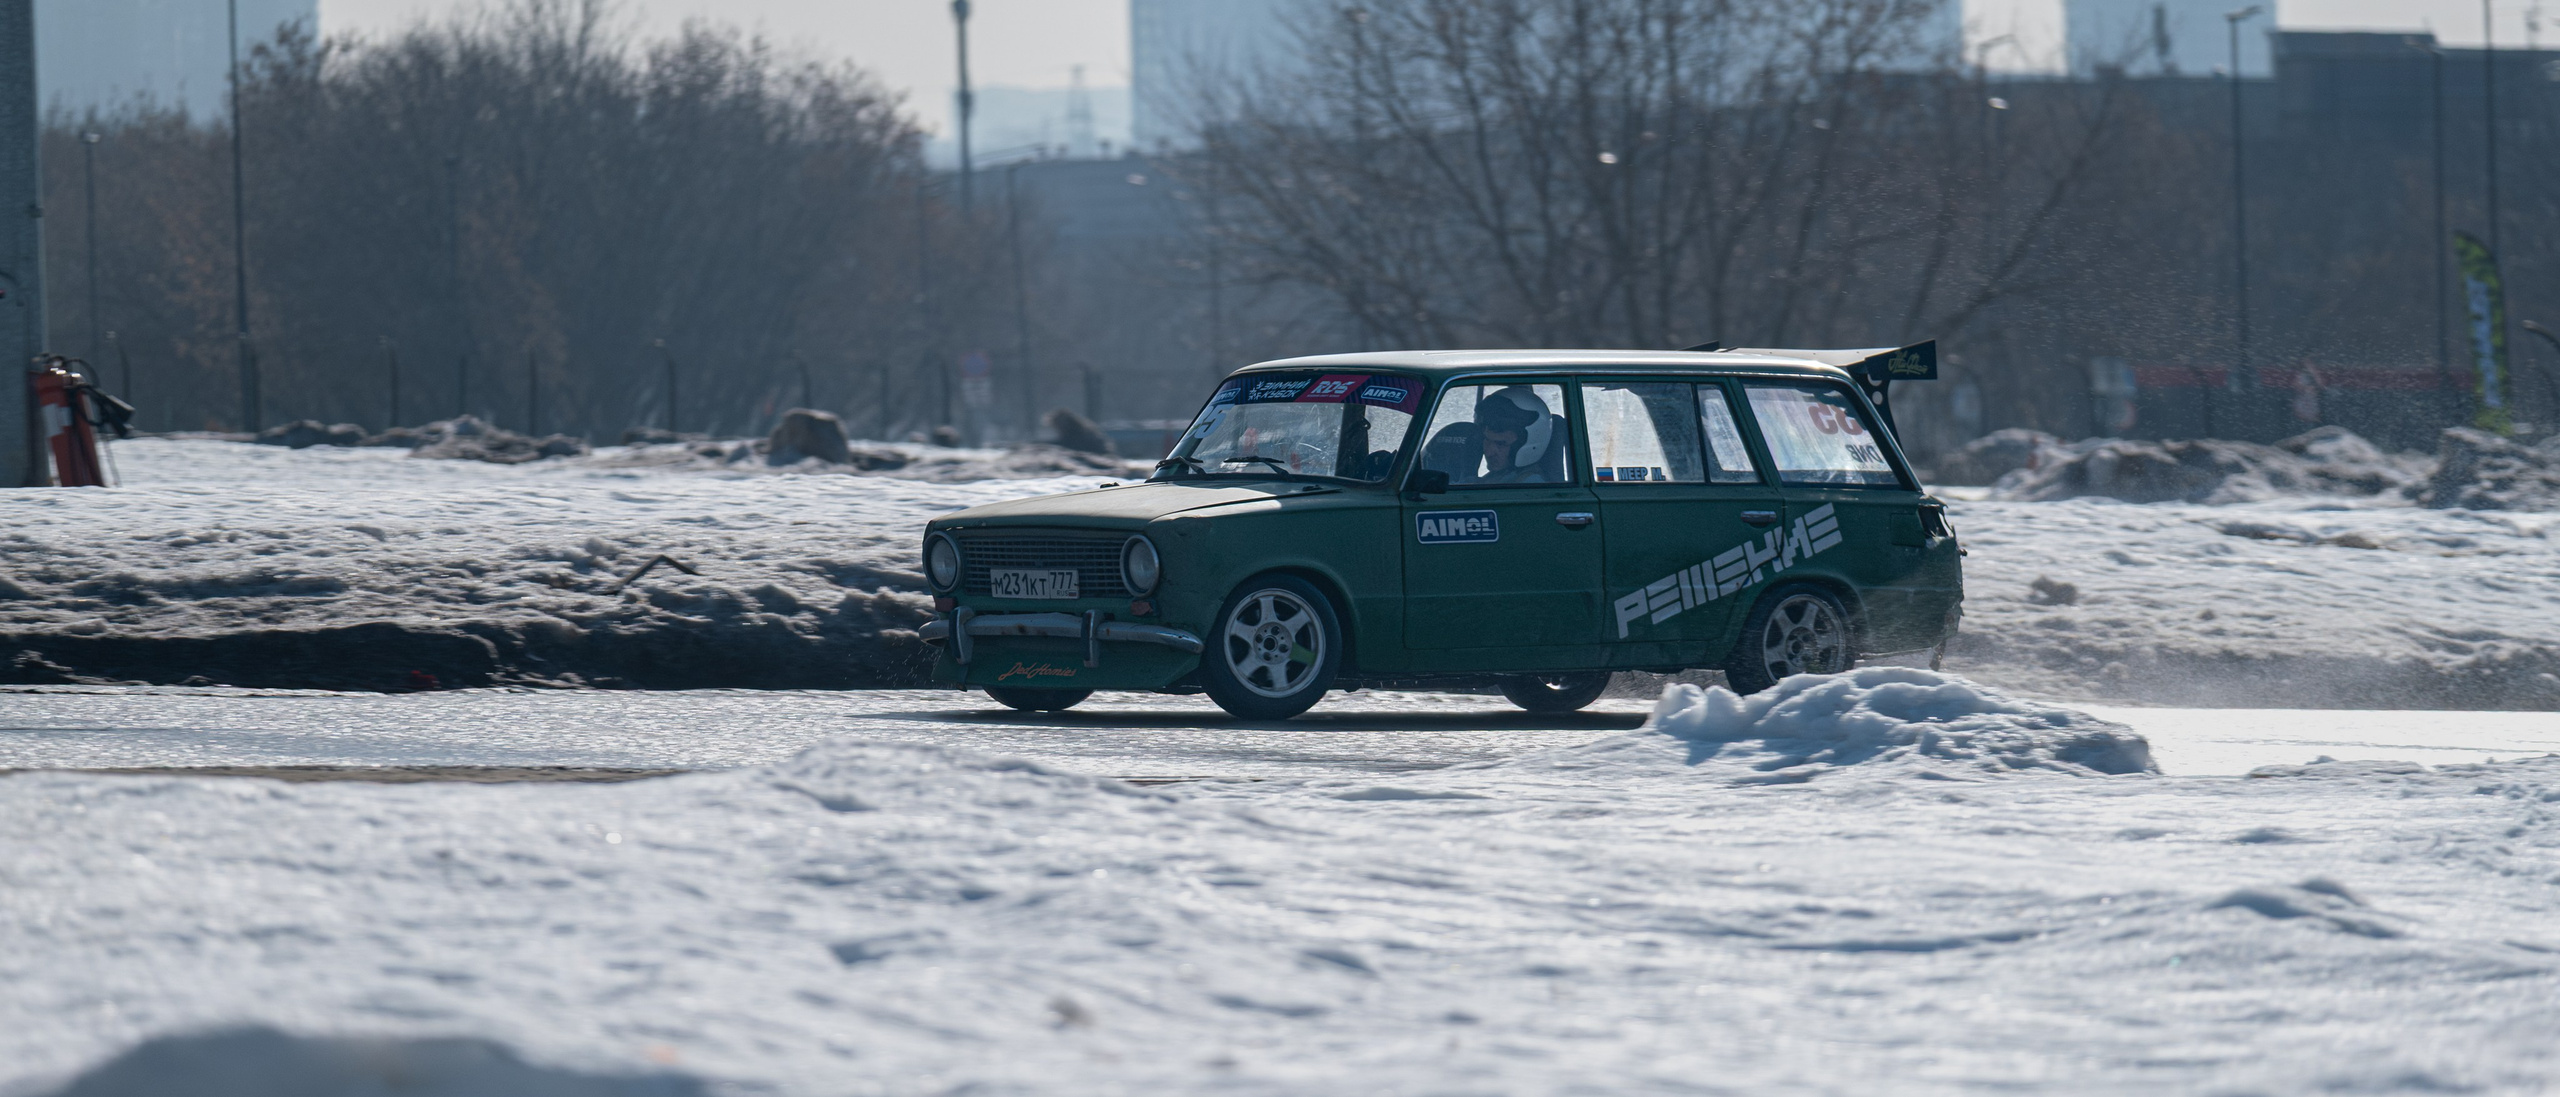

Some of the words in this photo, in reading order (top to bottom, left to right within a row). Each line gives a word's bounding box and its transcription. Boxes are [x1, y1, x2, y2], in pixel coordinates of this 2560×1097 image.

[1311, 380, 1355, 394] RDS
[1364, 388, 1402, 400] AIMOL
[1420, 517, 1495, 537] AIMOL
[1614, 502, 1843, 639] РЕШЕНИЕ
[1050, 571, 1073, 589] 777
